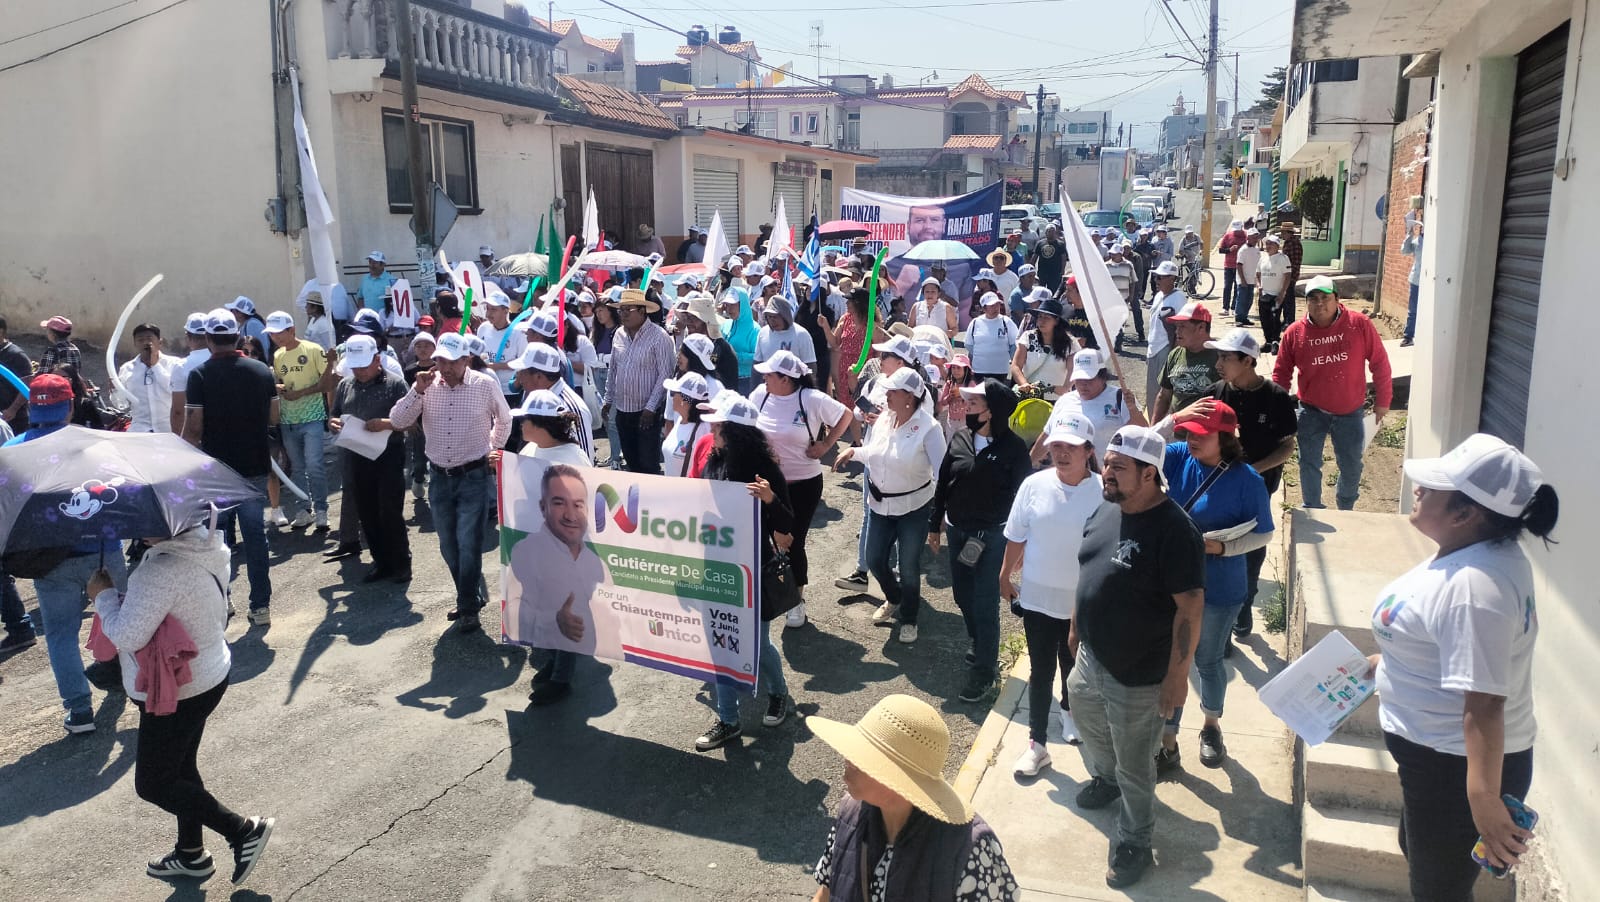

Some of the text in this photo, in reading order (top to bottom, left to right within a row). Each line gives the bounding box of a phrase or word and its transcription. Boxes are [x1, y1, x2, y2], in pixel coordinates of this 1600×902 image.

[841, 205, 881, 222] AVANZAR
[1309, 333, 1344, 346] TOMMY
[1312, 352, 1349, 366] JEANS
[595, 483, 735, 548] Nicolas
[607, 553, 735, 585] Gutiérrez De Casa
[644, 575, 675, 586] Presidente
[676, 580, 705, 592] Municipal
[598, 589, 629, 602] Por un
[611, 601, 701, 627] Chiautempan
[709, 608, 739, 625] Vota
[711, 620, 740, 635] 2 Junio
